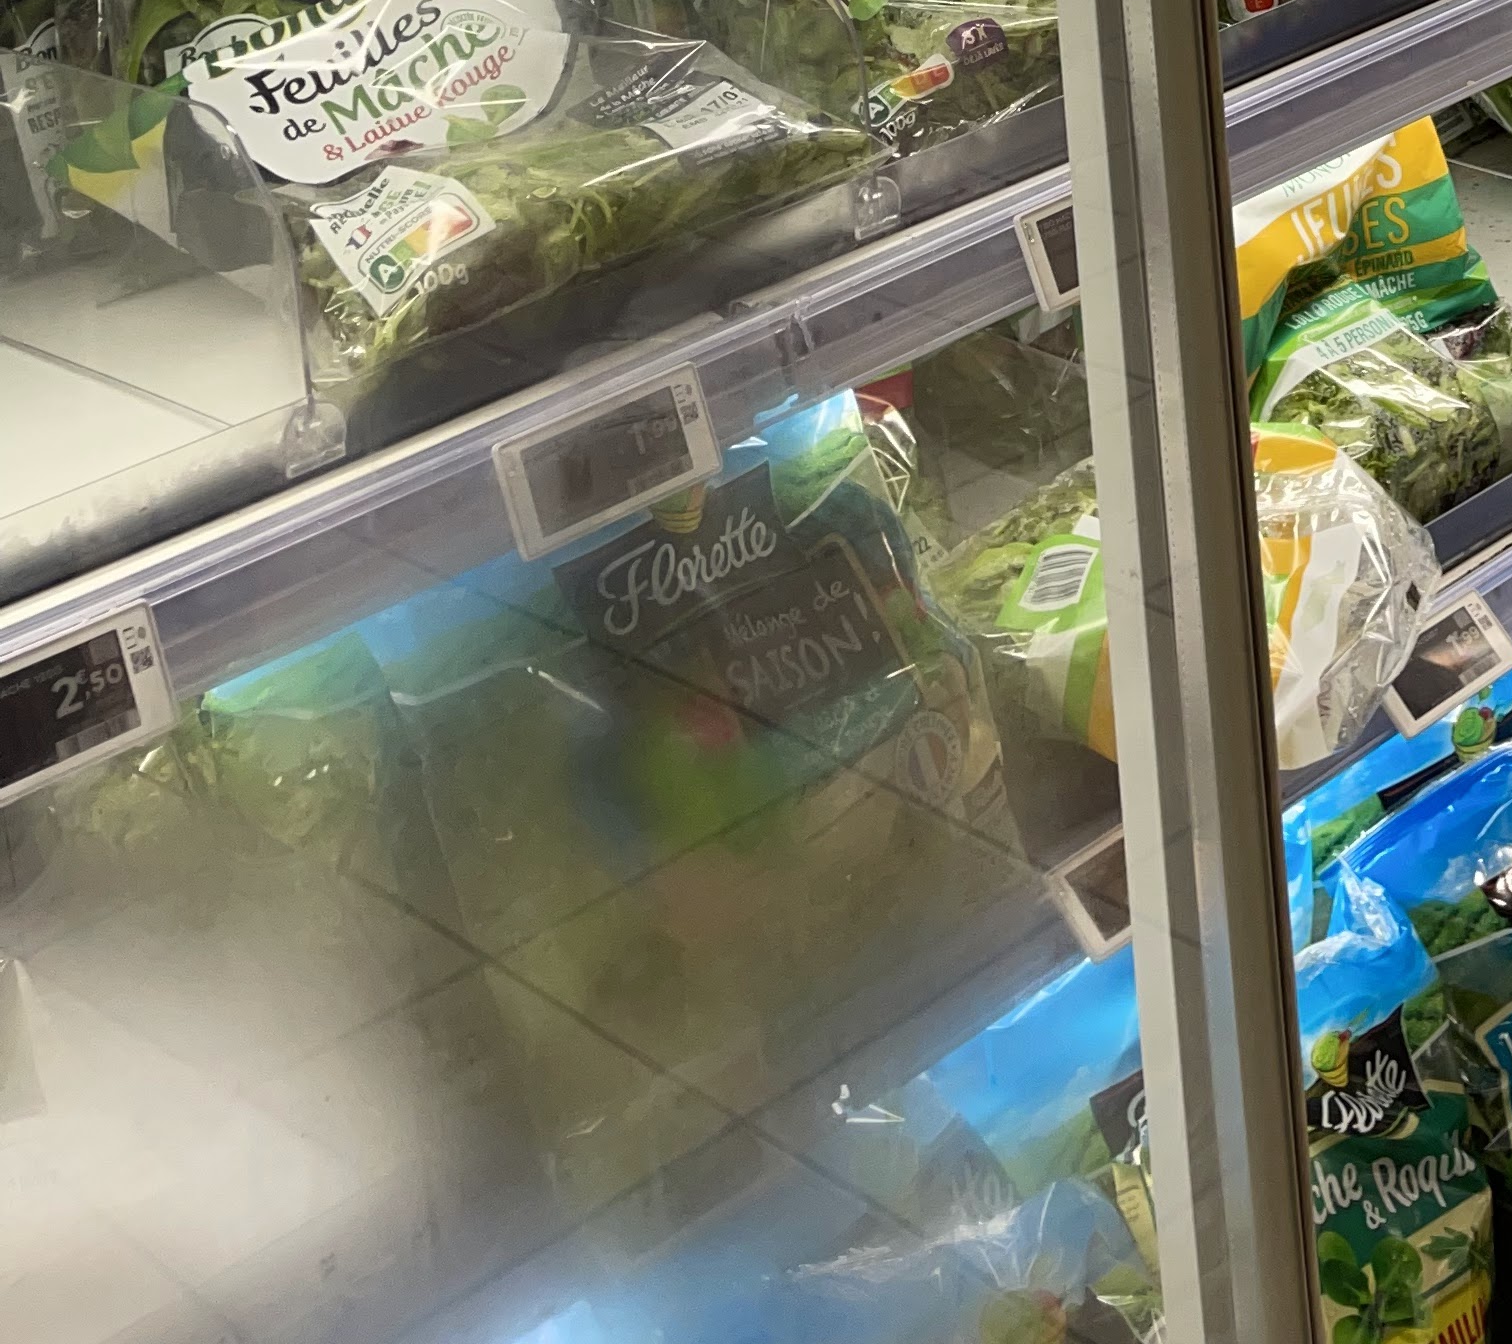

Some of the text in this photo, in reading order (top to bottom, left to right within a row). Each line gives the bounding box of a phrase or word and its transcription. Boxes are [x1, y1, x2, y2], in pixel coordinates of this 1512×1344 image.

[282, 14, 500, 142] de Mâche
[323, 143, 346, 162] &
[436, 44, 517, 109] Rouge
[879, 111, 917, 142] 100g
[1281, 148, 1353, 198] MONOP
[413, 263, 470, 295] 100g
[1354, 250, 1414, 278] ÉPINARD
[1327, 283, 1362, 315] ROUGE
[1362, 271, 1417, 298] MÂCHE
[1336, 333, 1347, 354] 5
[598, 506, 778, 637] Florette
[812, 578, 851, 614] de
[1310, 1160, 1364, 1225] che
[1363, 1199, 1387, 1230] &
